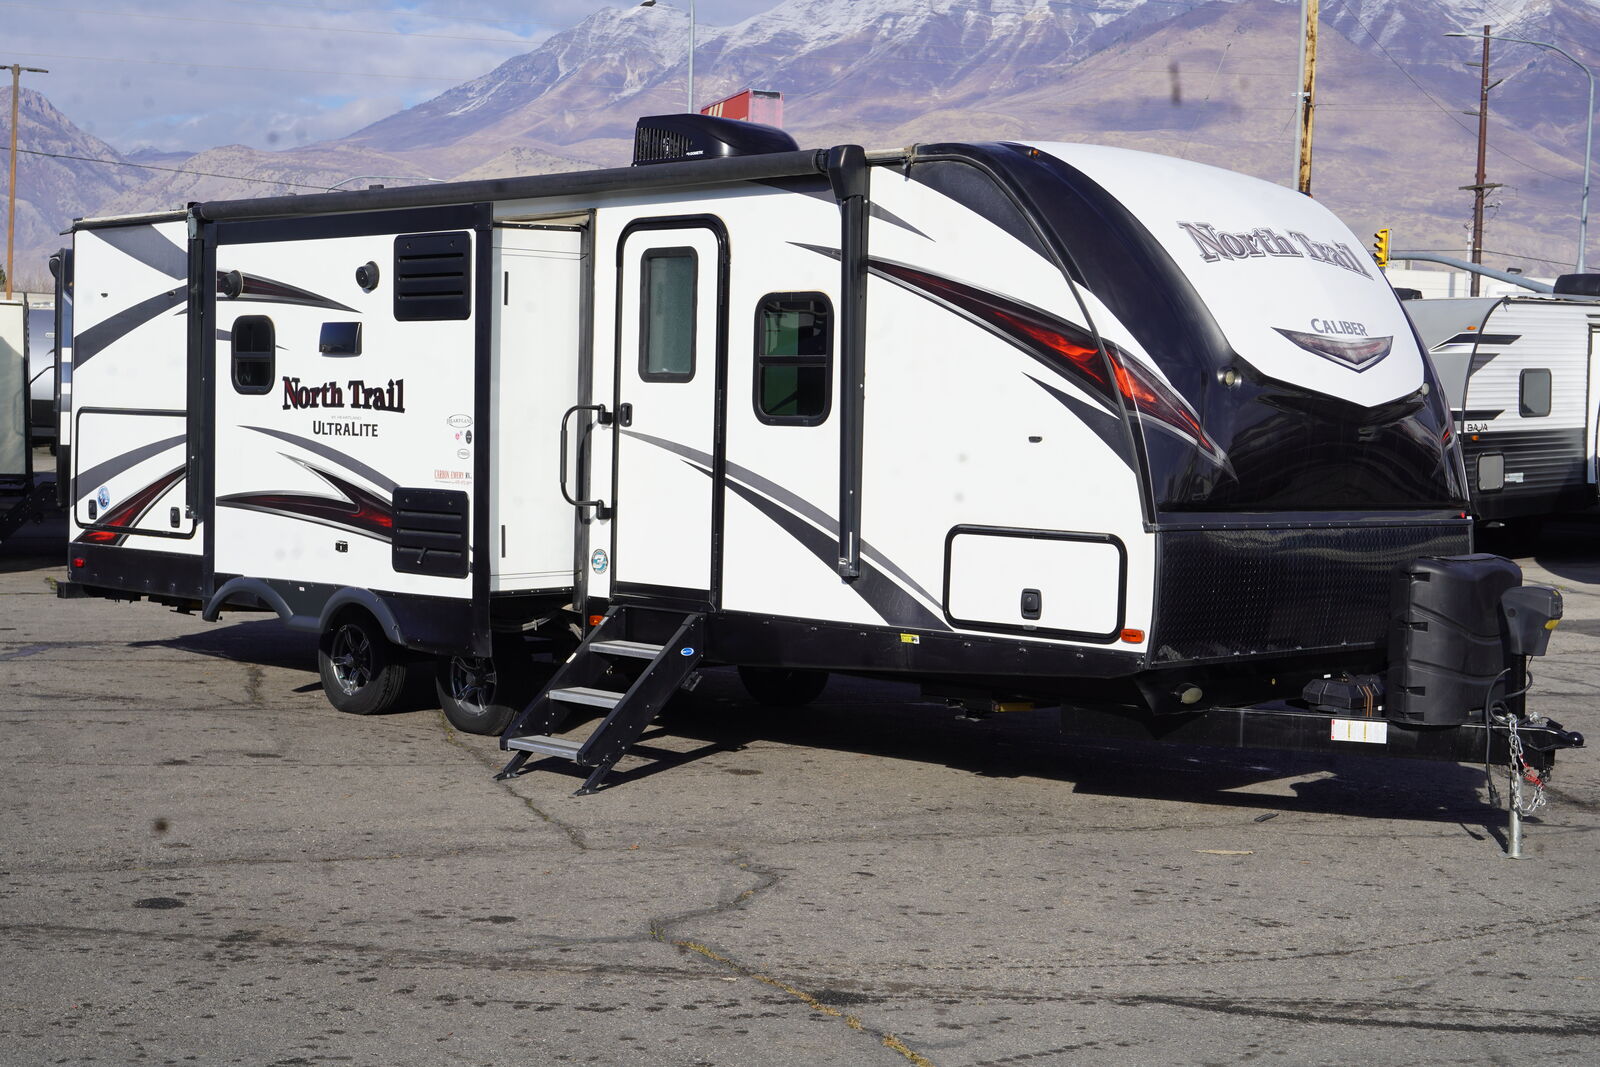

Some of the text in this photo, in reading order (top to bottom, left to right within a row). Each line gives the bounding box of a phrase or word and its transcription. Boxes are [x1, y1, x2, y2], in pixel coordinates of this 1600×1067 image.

[1176, 221, 1375, 280] North Trail
[1310, 318, 1368, 336] CALIBER
[282, 376, 405, 413] North Trail
[1467, 423, 1488, 432] BAJA
